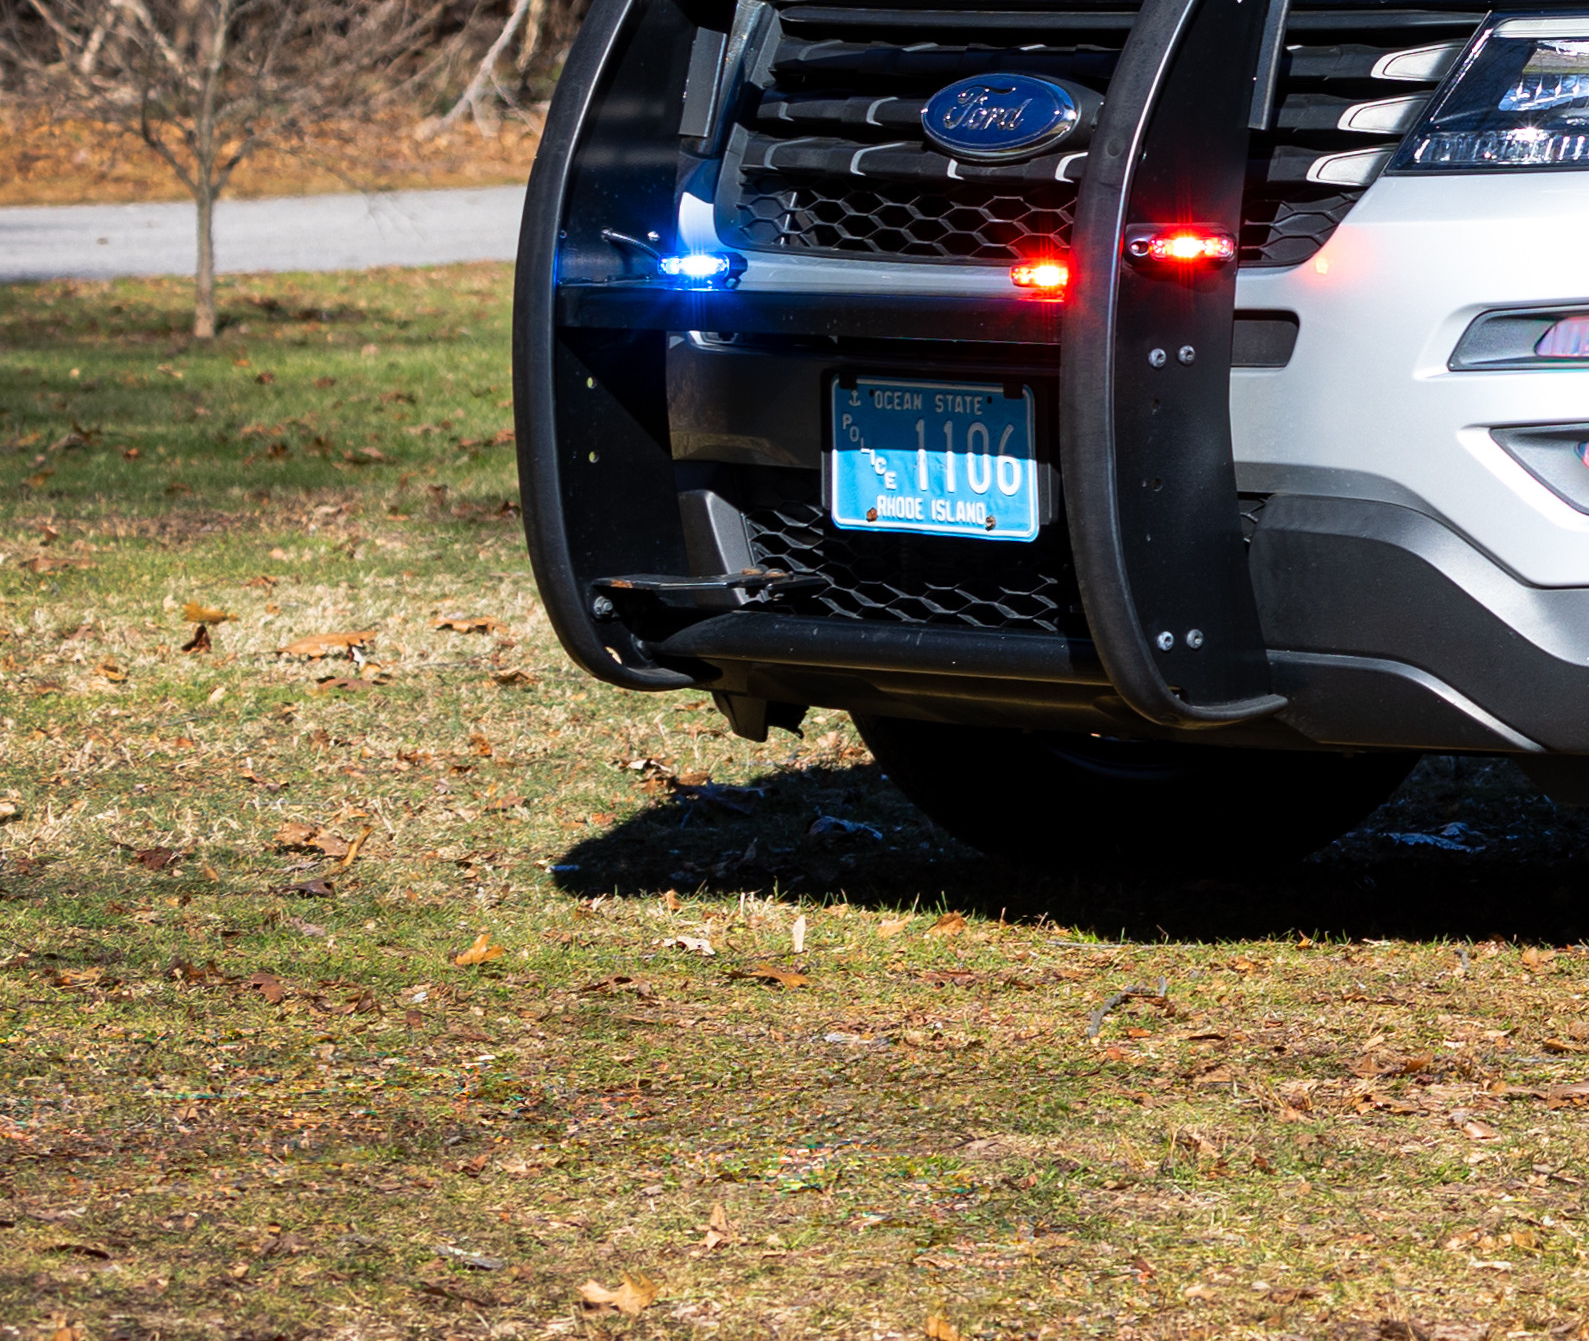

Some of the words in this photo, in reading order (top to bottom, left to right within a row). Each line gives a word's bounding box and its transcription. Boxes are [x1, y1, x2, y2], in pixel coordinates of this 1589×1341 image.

[943, 84, 1033, 131] Ford
[874, 390, 922, 410] OCEAN
[935, 394, 983, 415] STATE
[842, 414, 897, 490] POLICE
[915, 419, 1021, 496] 1106
[876, 495, 924, 520] RHODE
[931, 498, 986, 525] ISLAND
